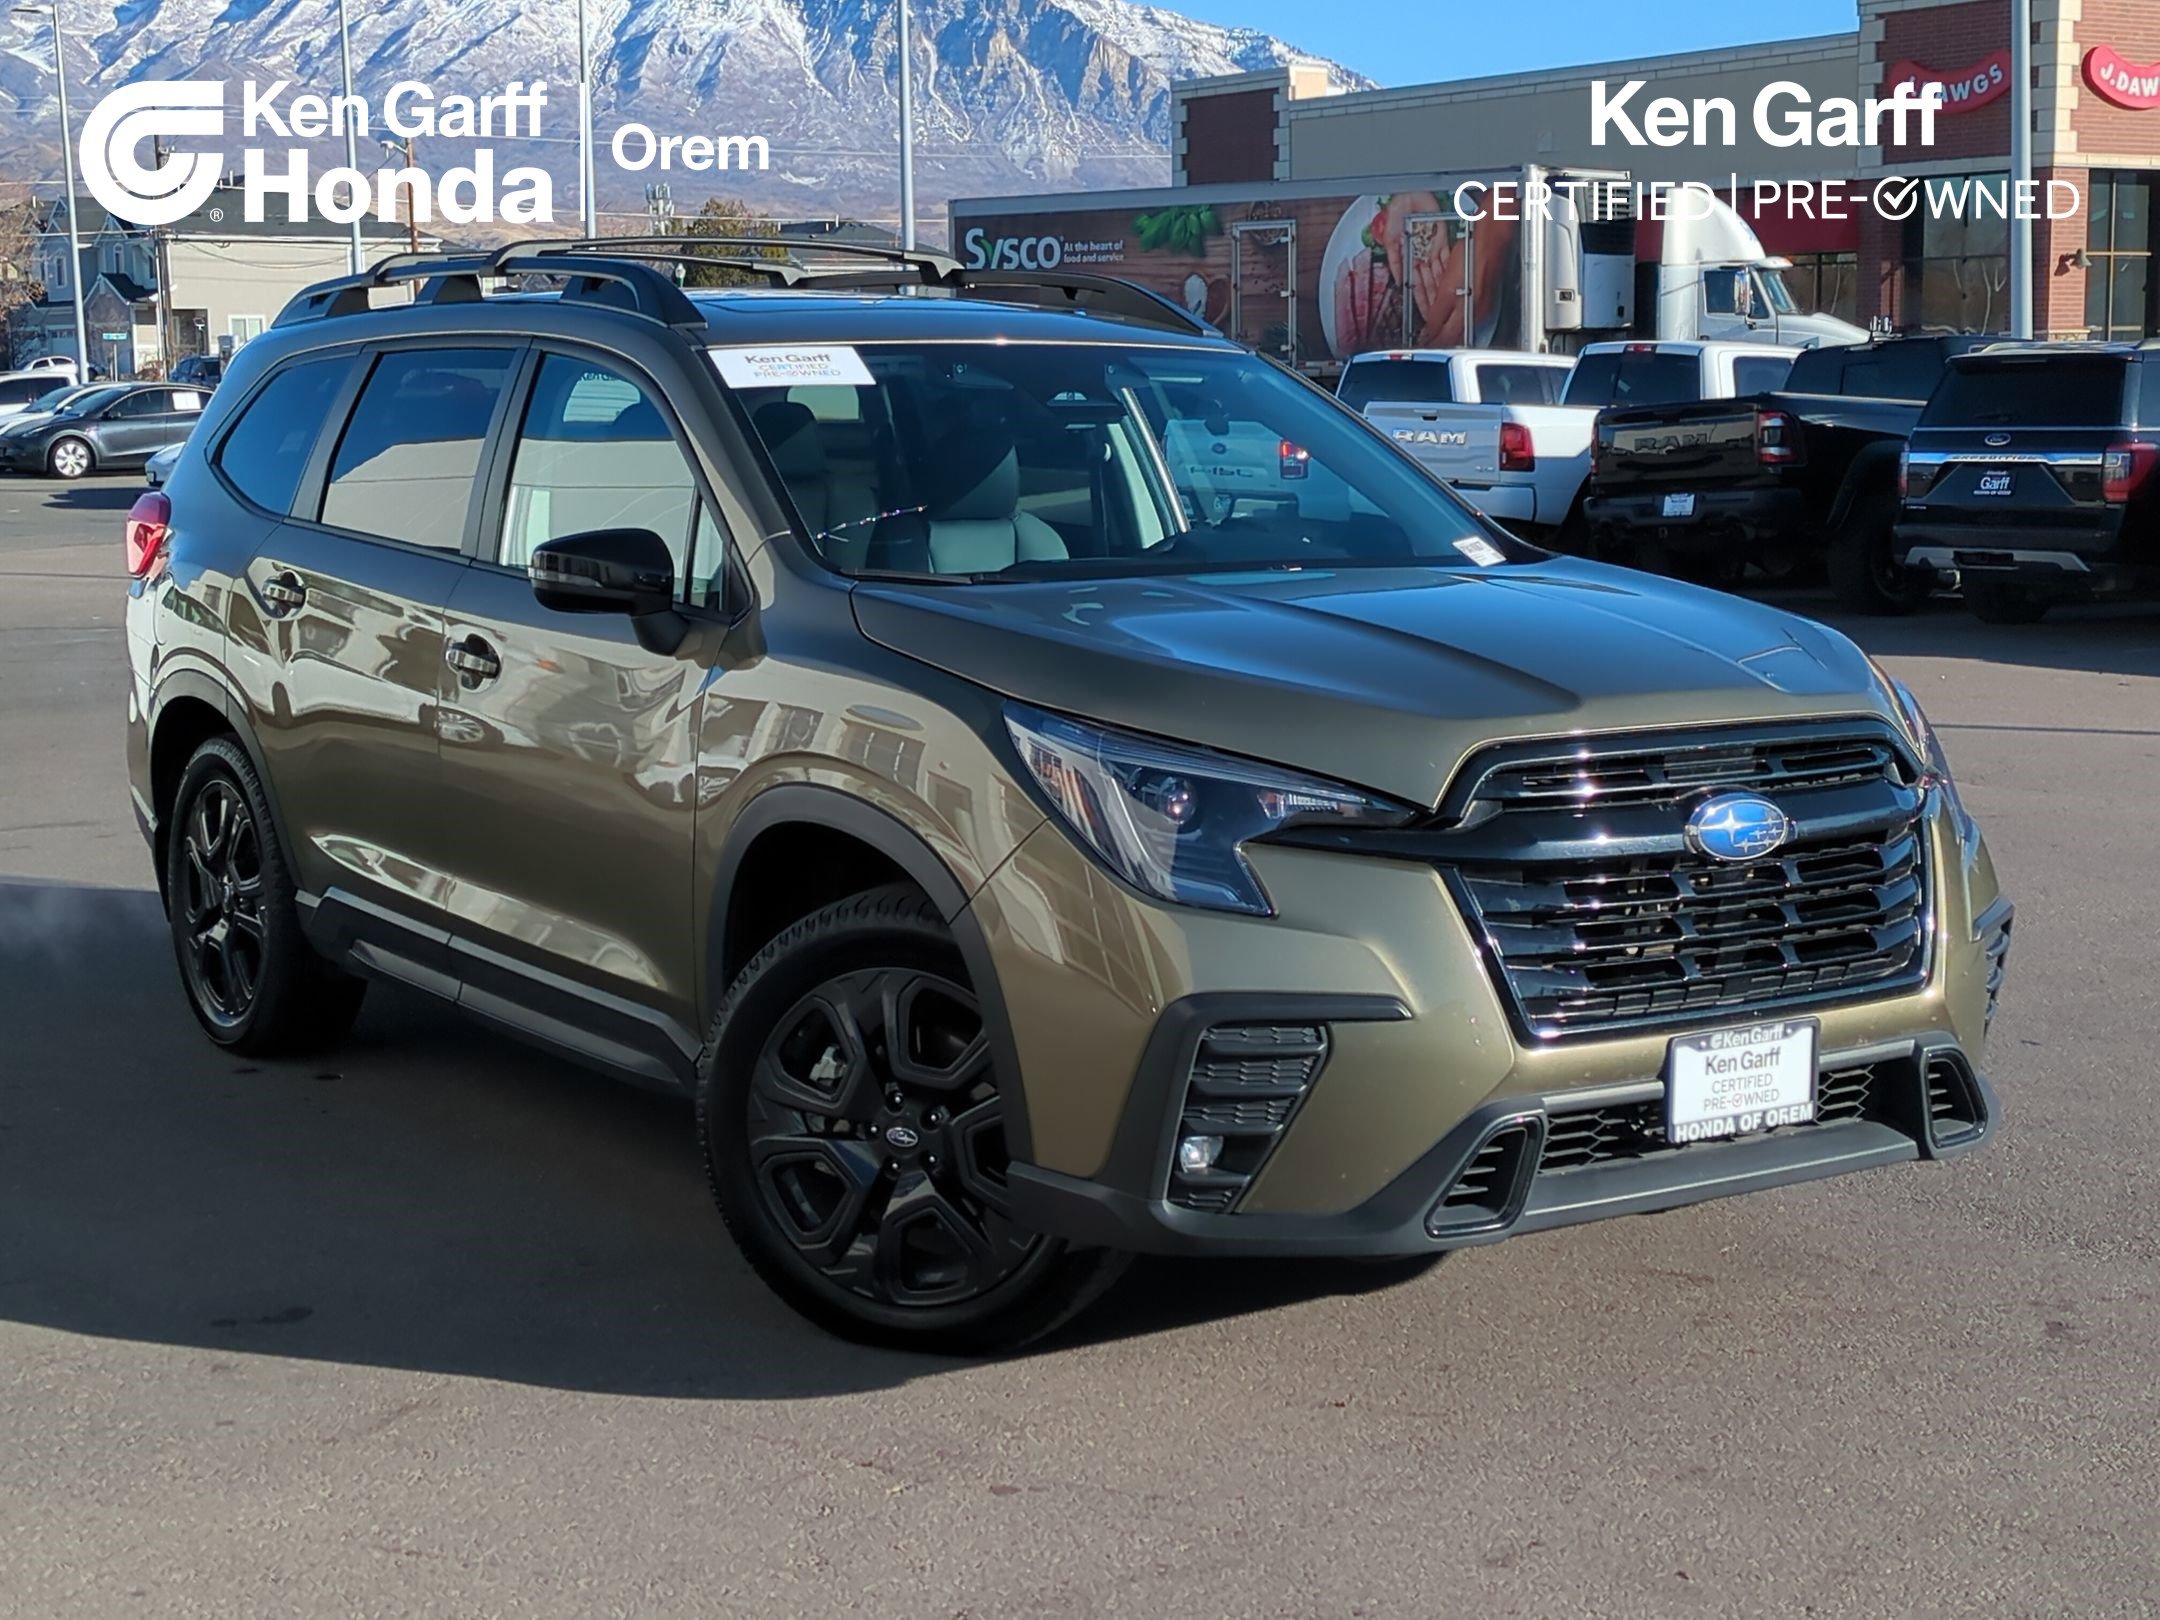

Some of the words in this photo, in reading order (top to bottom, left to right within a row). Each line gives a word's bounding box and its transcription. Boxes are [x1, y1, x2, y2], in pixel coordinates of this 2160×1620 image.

[1074, 241, 1089, 252] the
[1090, 240, 1113, 251] heart
[1063, 253, 1081, 263] food
[1082, 252, 1097, 262] and
[745, 354, 783, 364] Ken
[785, 353, 832, 363] Garff
[758, 363, 829, 371] CERTIFIED
[1393, 429, 1467, 446] RAM
[1634, 433, 1708, 451] RAM
[1980, 476, 2010, 490] Garff
[1722, 1030, 1749, 1049] Ken
[1750, 1023, 1785, 1045] Garff
[1704, 1054, 1738, 1076] Ken
[1740, 1046, 1781, 1071] Garff
[1712, 1073, 1773, 1095] CERTIFIED
[1675, 1117, 1736, 1143] HONDA
[1738, 1111, 1763, 1132] OF
[1765, 1102, 1813, 1127] OREM
